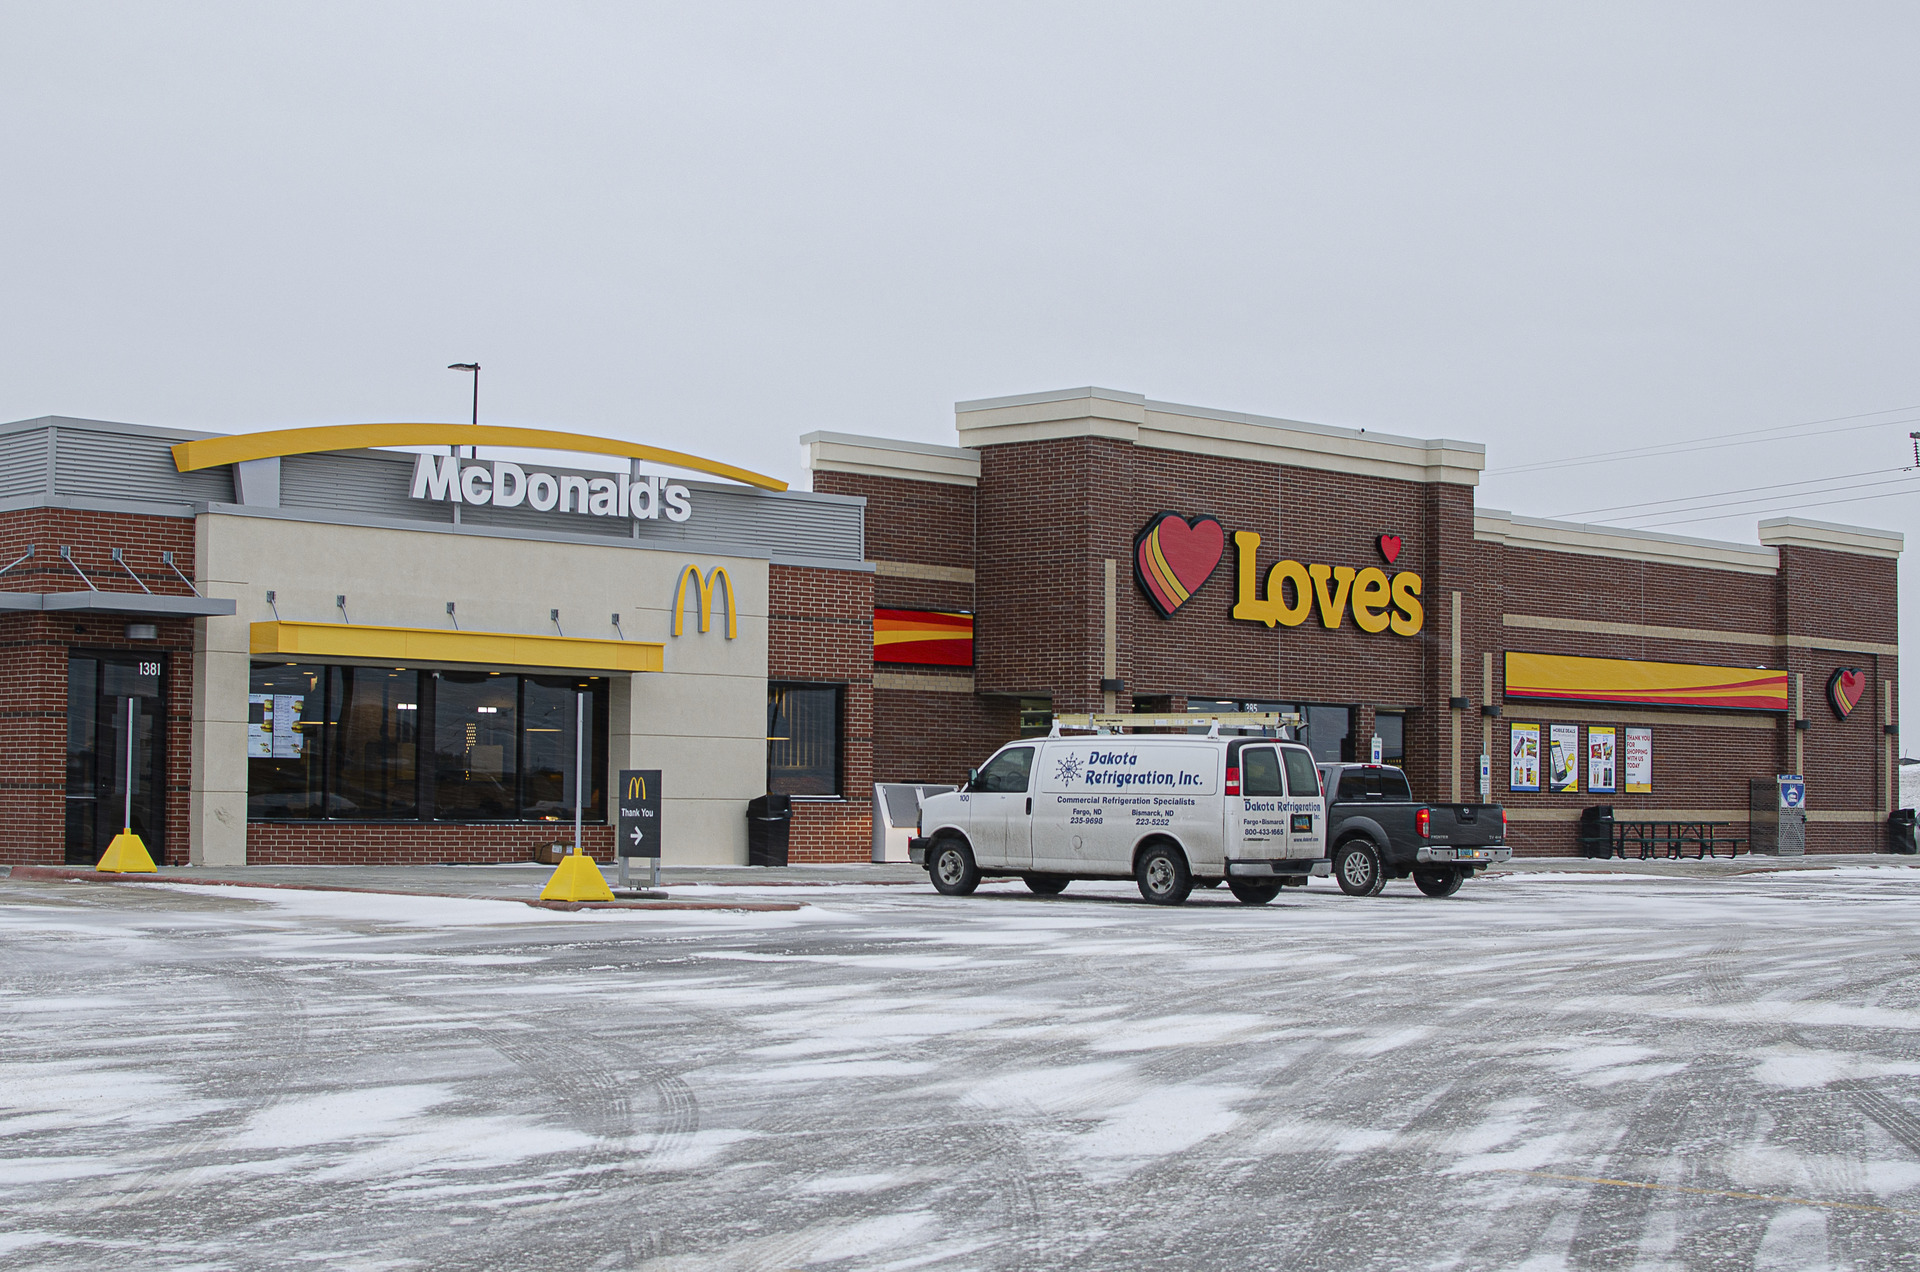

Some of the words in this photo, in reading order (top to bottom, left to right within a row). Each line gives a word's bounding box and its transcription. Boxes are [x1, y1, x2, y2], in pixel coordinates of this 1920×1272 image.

[411, 453, 692, 523] McDonald's
[139, 662, 160, 676] 1381
[1088, 751, 1138, 766] Dakota
[1085, 770, 1176, 788] Refrigeration,
[1179, 770, 1203, 786] Inc.
[959, 794, 970, 802] 100
[1057, 796, 1100, 804] Commercial
[1102, 796, 1151, 805] Refrigeration
[1153, 797, 1195, 806] Specialists
[1072, 808, 1092, 816] Fargo,
[1245, 801, 1274, 811] Dakota
[1277, 801, 1321, 813] Refrigeration
[621, 807, 640, 817] Thank
[641, 807, 654, 818] You
[1131, 809, 1163, 817] Bismarck,
[1164, 809, 1174, 817] ND
[1070, 817, 1103, 825] 235-9698
[1135, 818, 1170, 826] 223-5252
[1243, 818, 1259, 826] Fargo
